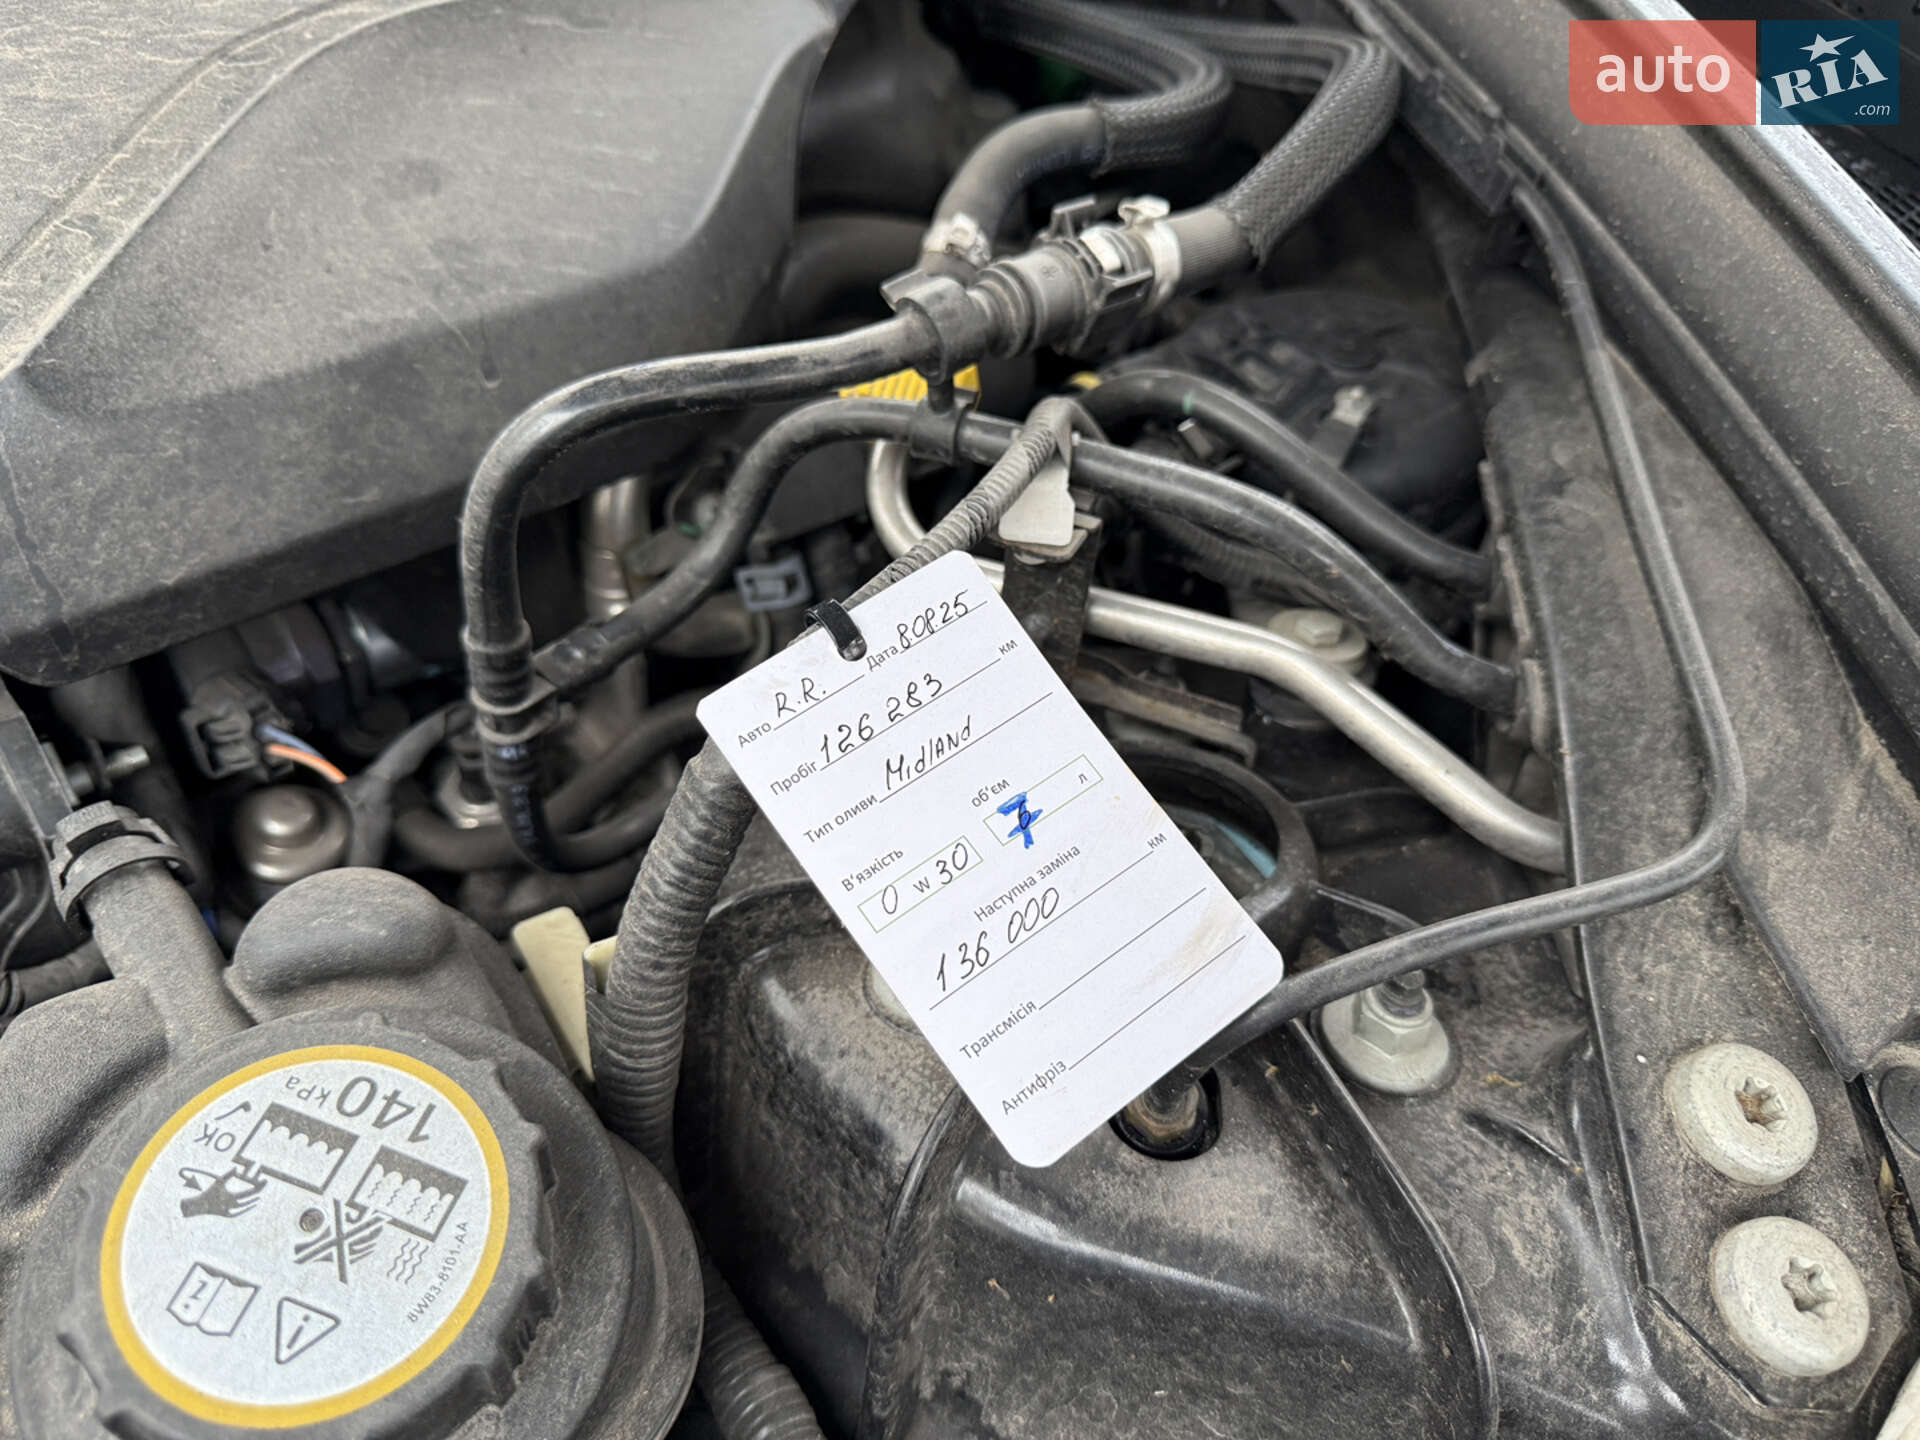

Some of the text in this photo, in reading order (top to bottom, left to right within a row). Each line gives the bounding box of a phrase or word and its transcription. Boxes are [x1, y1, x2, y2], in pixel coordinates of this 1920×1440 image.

[866, 645, 899, 672] Дата
[998, 639, 1019, 656] км
[737, 722, 772, 749] Авто
[820, 673, 942, 763] 126 283
[770, 762, 819, 796] Пробіг
[803, 794, 878, 843] Тип оливи
[1147, 832, 1168, 851] км
[936, 843, 969, 886] 30
[974, 845, 1081, 923] Наступна заміна
[1007, 887, 1060, 945] 000
[959, 999, 1038, 1061] Трансмісія
[285, 1075, 437, 1143] 140 kPa
[1001, 1058, 1068, 1115] Антифріз
[194, 1123, 236, 1152] OK
